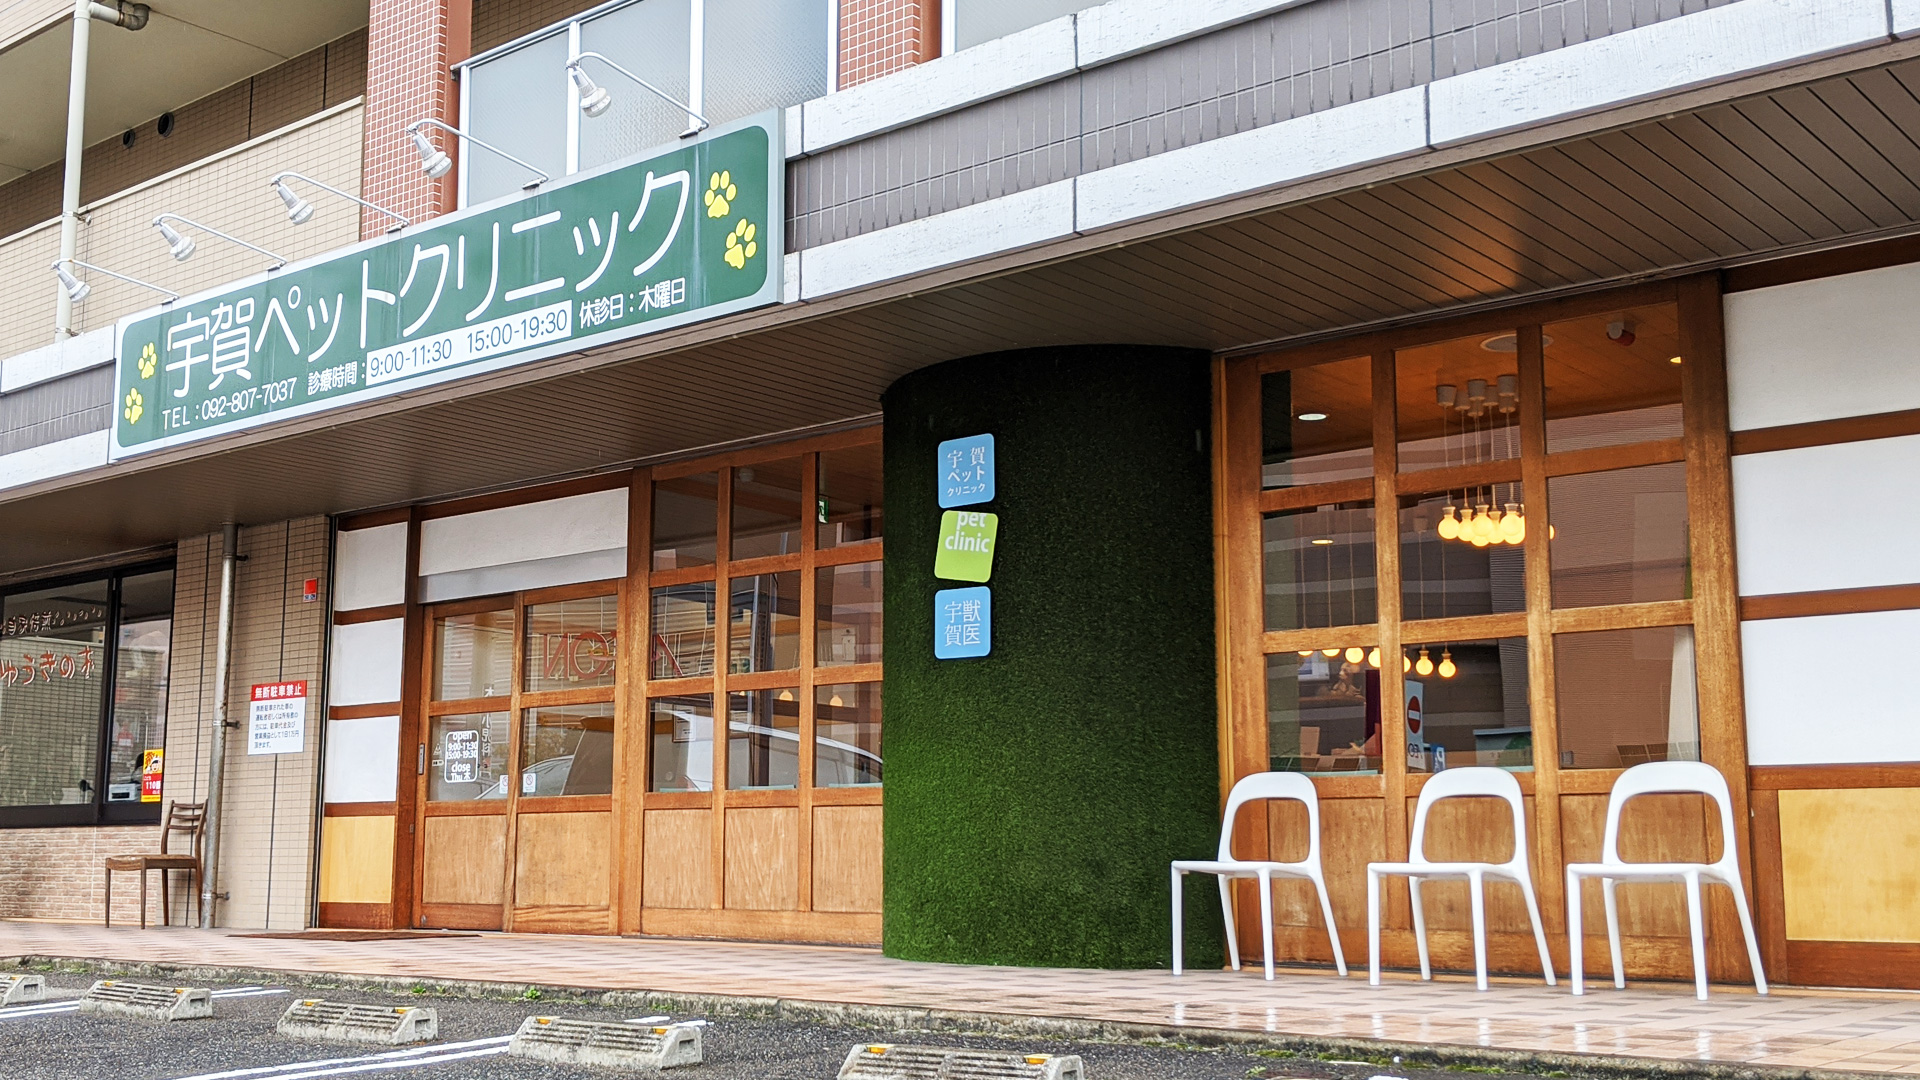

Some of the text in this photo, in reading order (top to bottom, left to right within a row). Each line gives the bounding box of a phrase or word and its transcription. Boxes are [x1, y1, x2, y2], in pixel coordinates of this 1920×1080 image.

[165, 170, 691, 398] 宇賀ペットクリニック
[370, 338, 452, 378] 9:00-11:30
[467, 308, 568, 354] 15:00-19:30
[947, 465, 985, 483] ペット
[947, 484, 986, 497] クリニック
[956, 511, 986, 531] pet
[944, 529, 991, 553] clinic
[254, 683, 302, 698] 無断駐車禁止
[453, 732, 472, 743] open
[448, 742, 477, 751] 9:00-11:30
[451, 761, 471, 772] close
